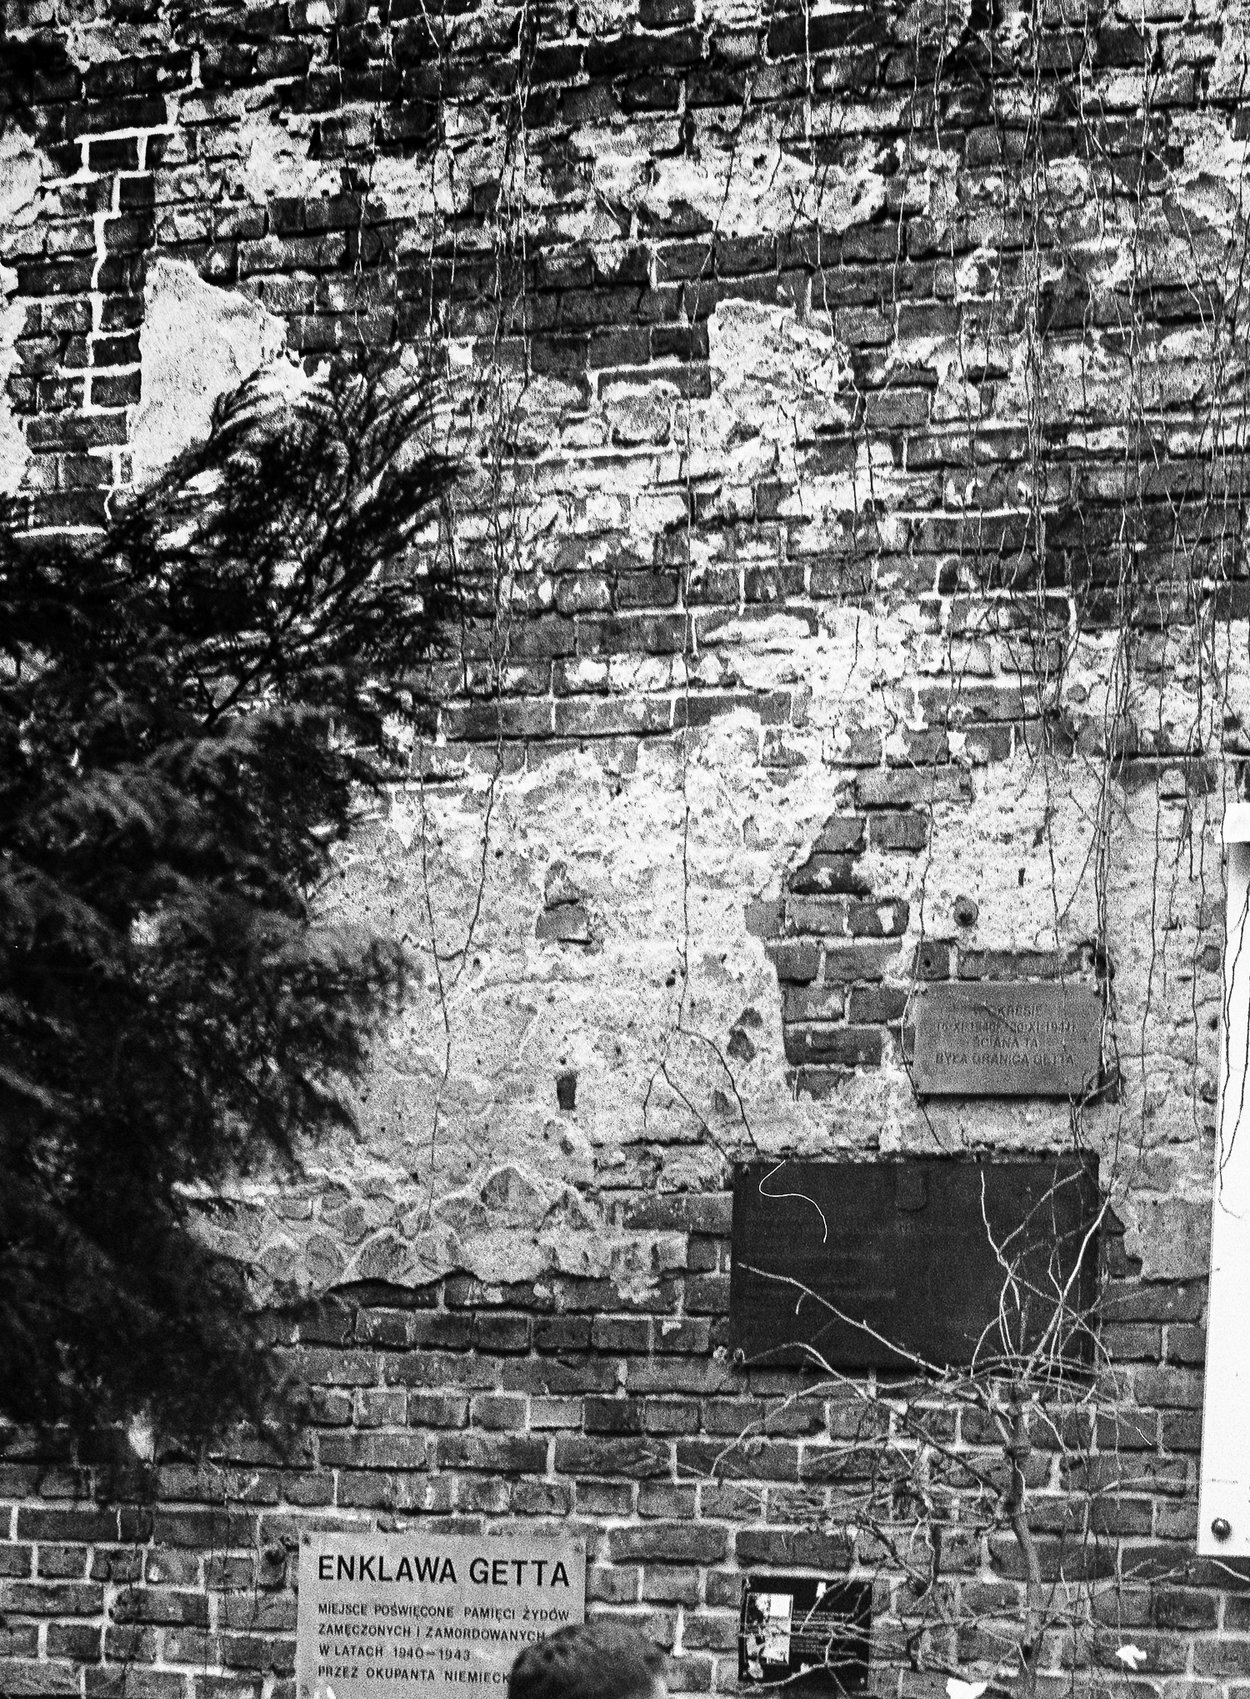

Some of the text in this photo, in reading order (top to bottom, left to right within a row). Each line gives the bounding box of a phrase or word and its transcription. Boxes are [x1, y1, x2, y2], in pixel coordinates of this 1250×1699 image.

[318, 1555, 571, 1588] ENKLAWA GETTA
[318, 1602, 570, 1623] MIEJSCE POŚWIĘCONE PAMIĘCI ŻYDÓW
[318, 1623, 411, 1638] ZAMĘCZONYCH
[426, 1626, 547, 1642] ZAMORDOWANYCH
[319, 1643, 330, 1656] W
[334, 1645, 383, 1657] LATACH
[318, 1665, 358, 1679] PRZEZ
[366, 1667, 434, 1681] OKUPANTA
